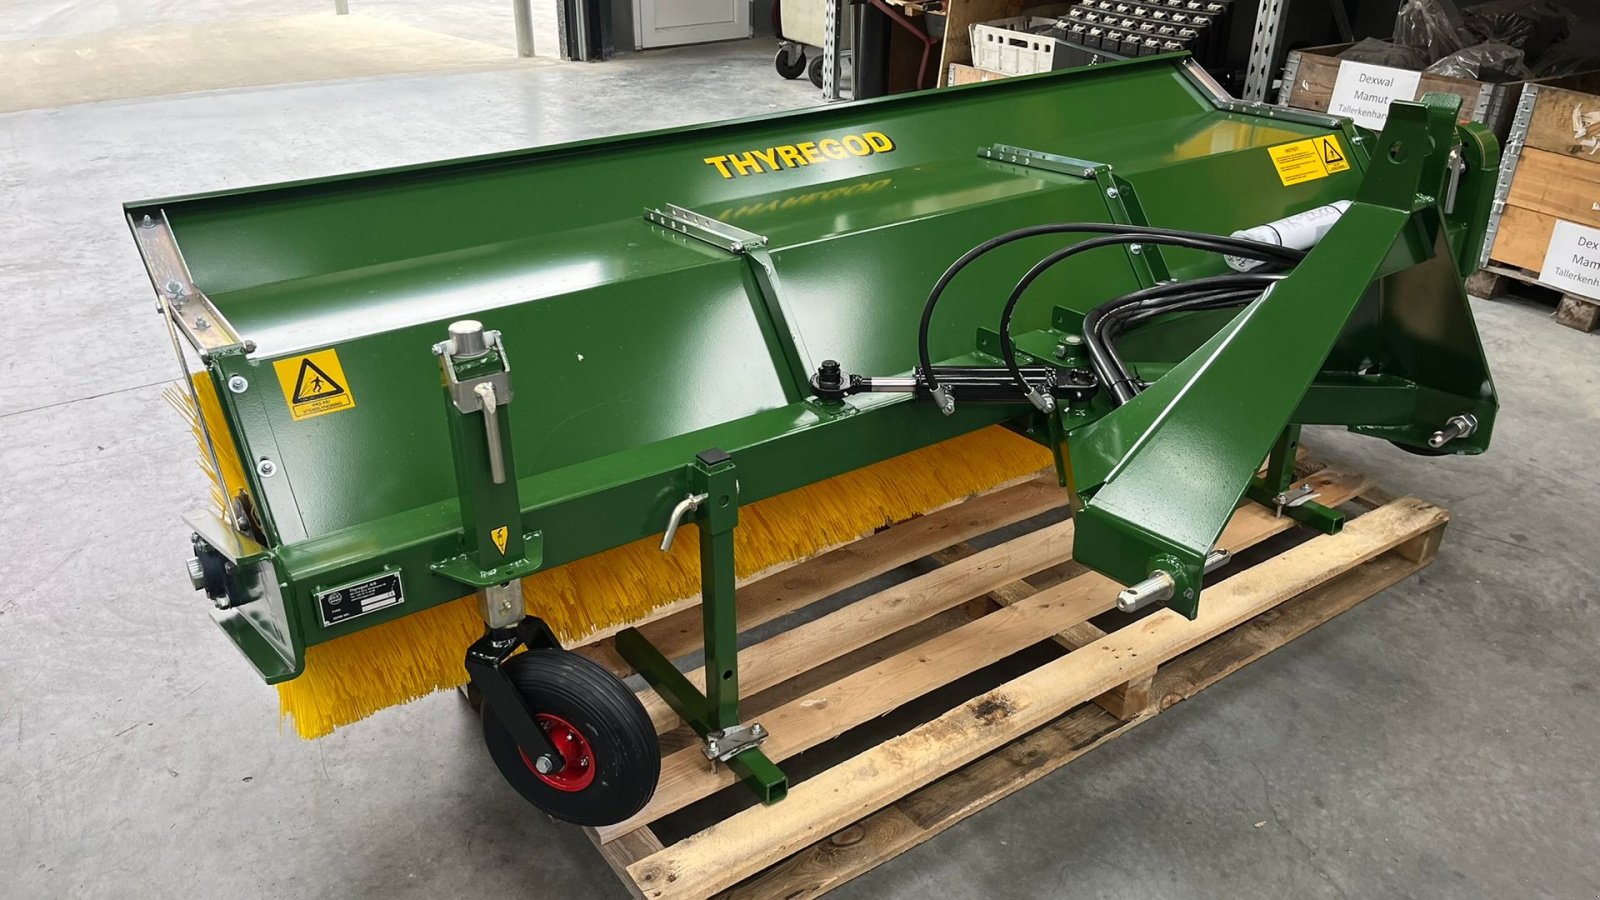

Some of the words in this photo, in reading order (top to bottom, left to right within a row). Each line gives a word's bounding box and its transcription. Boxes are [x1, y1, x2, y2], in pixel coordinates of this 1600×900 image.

[1358, 73, 1394, 87] Dexwal
[1353, 90, 1389, 105] Mamut
[703, 131, 896, 179] THYREGOD
[1577, 236, 1599, 250] Dex
[1572, 254, 1600, 270] Mam
